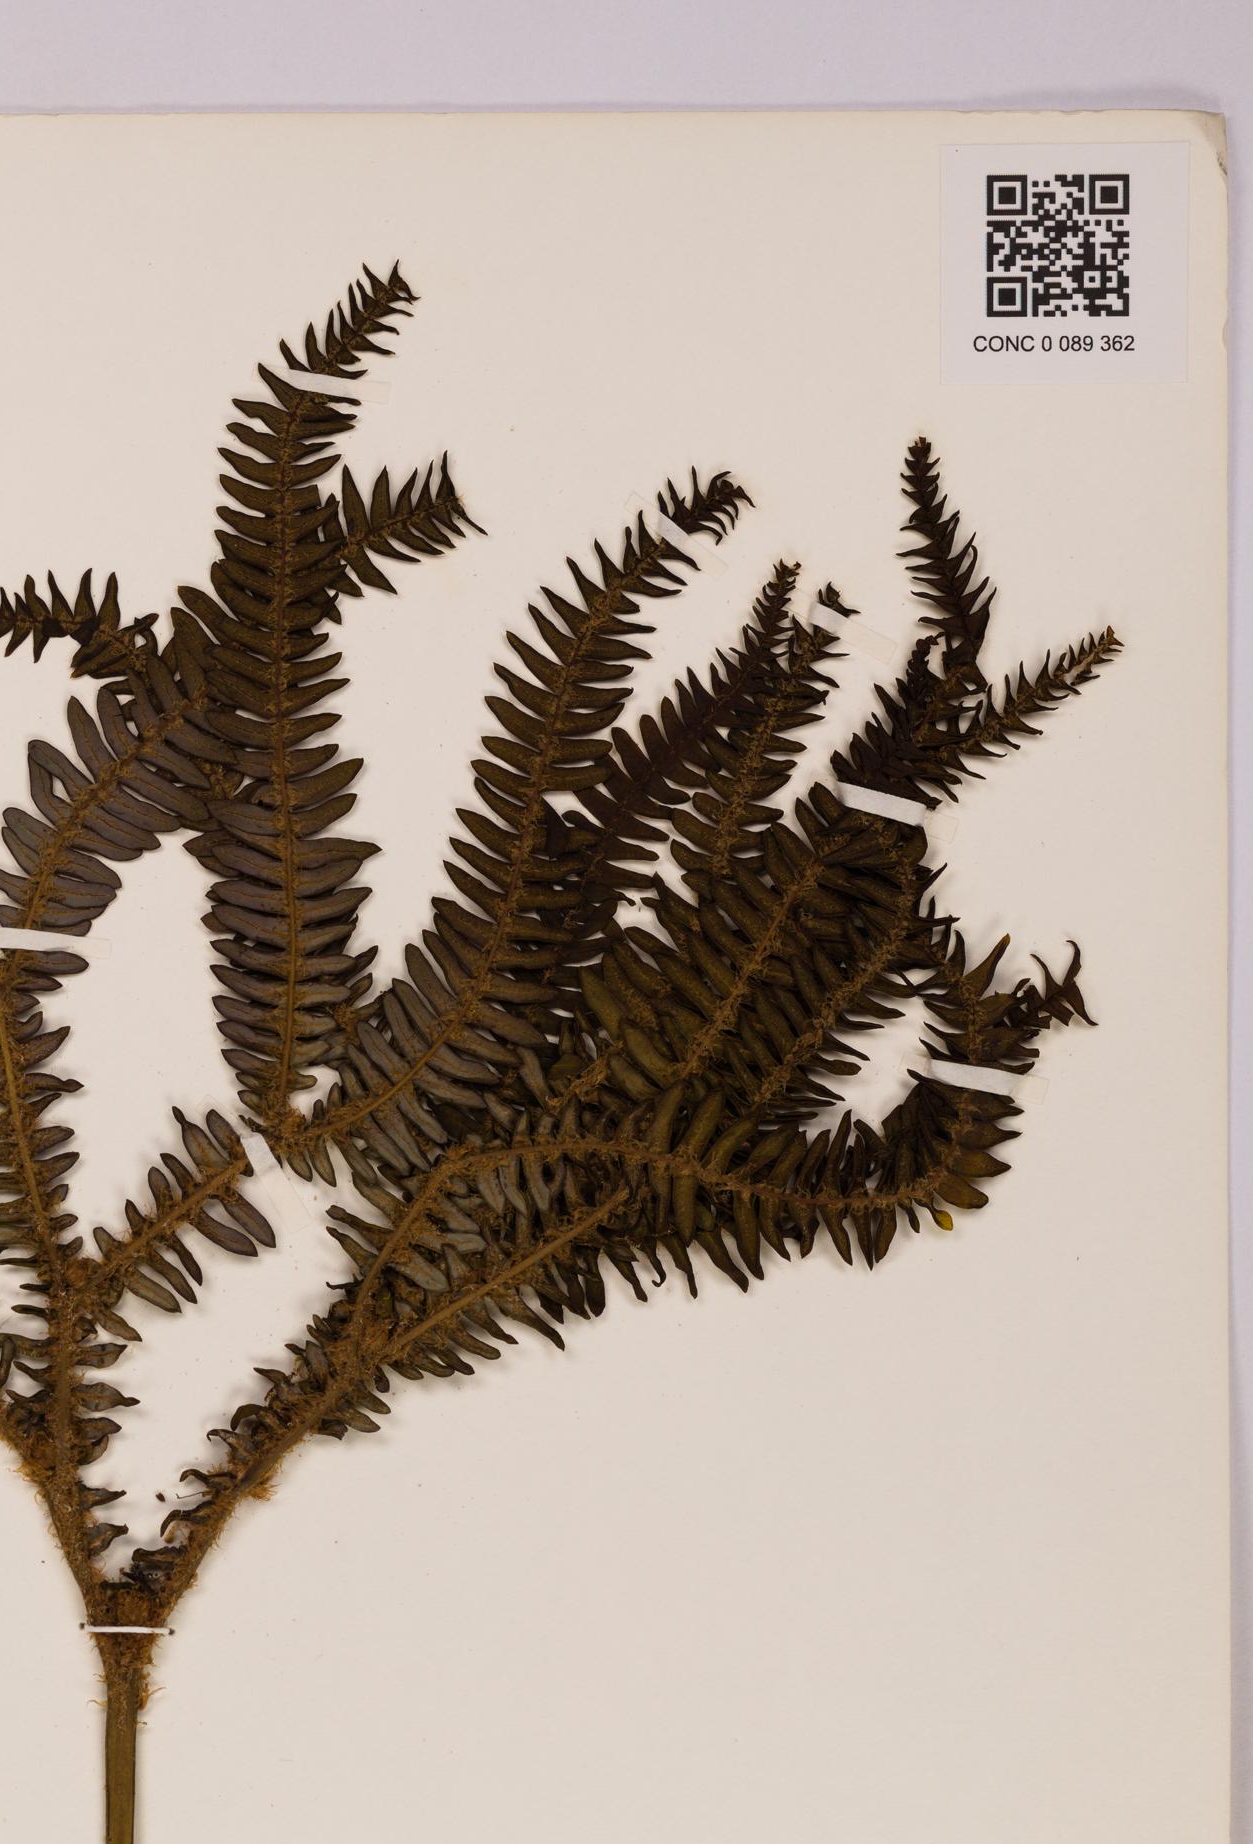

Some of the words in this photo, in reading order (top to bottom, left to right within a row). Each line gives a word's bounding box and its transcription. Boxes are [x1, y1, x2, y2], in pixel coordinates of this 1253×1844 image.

[973, 335, 1036, 353] CONC
[1041, 335, 1054, 353] 0
[1059, 335, 1095, 353] 089
[1100, 335, 1136, 353] 362
